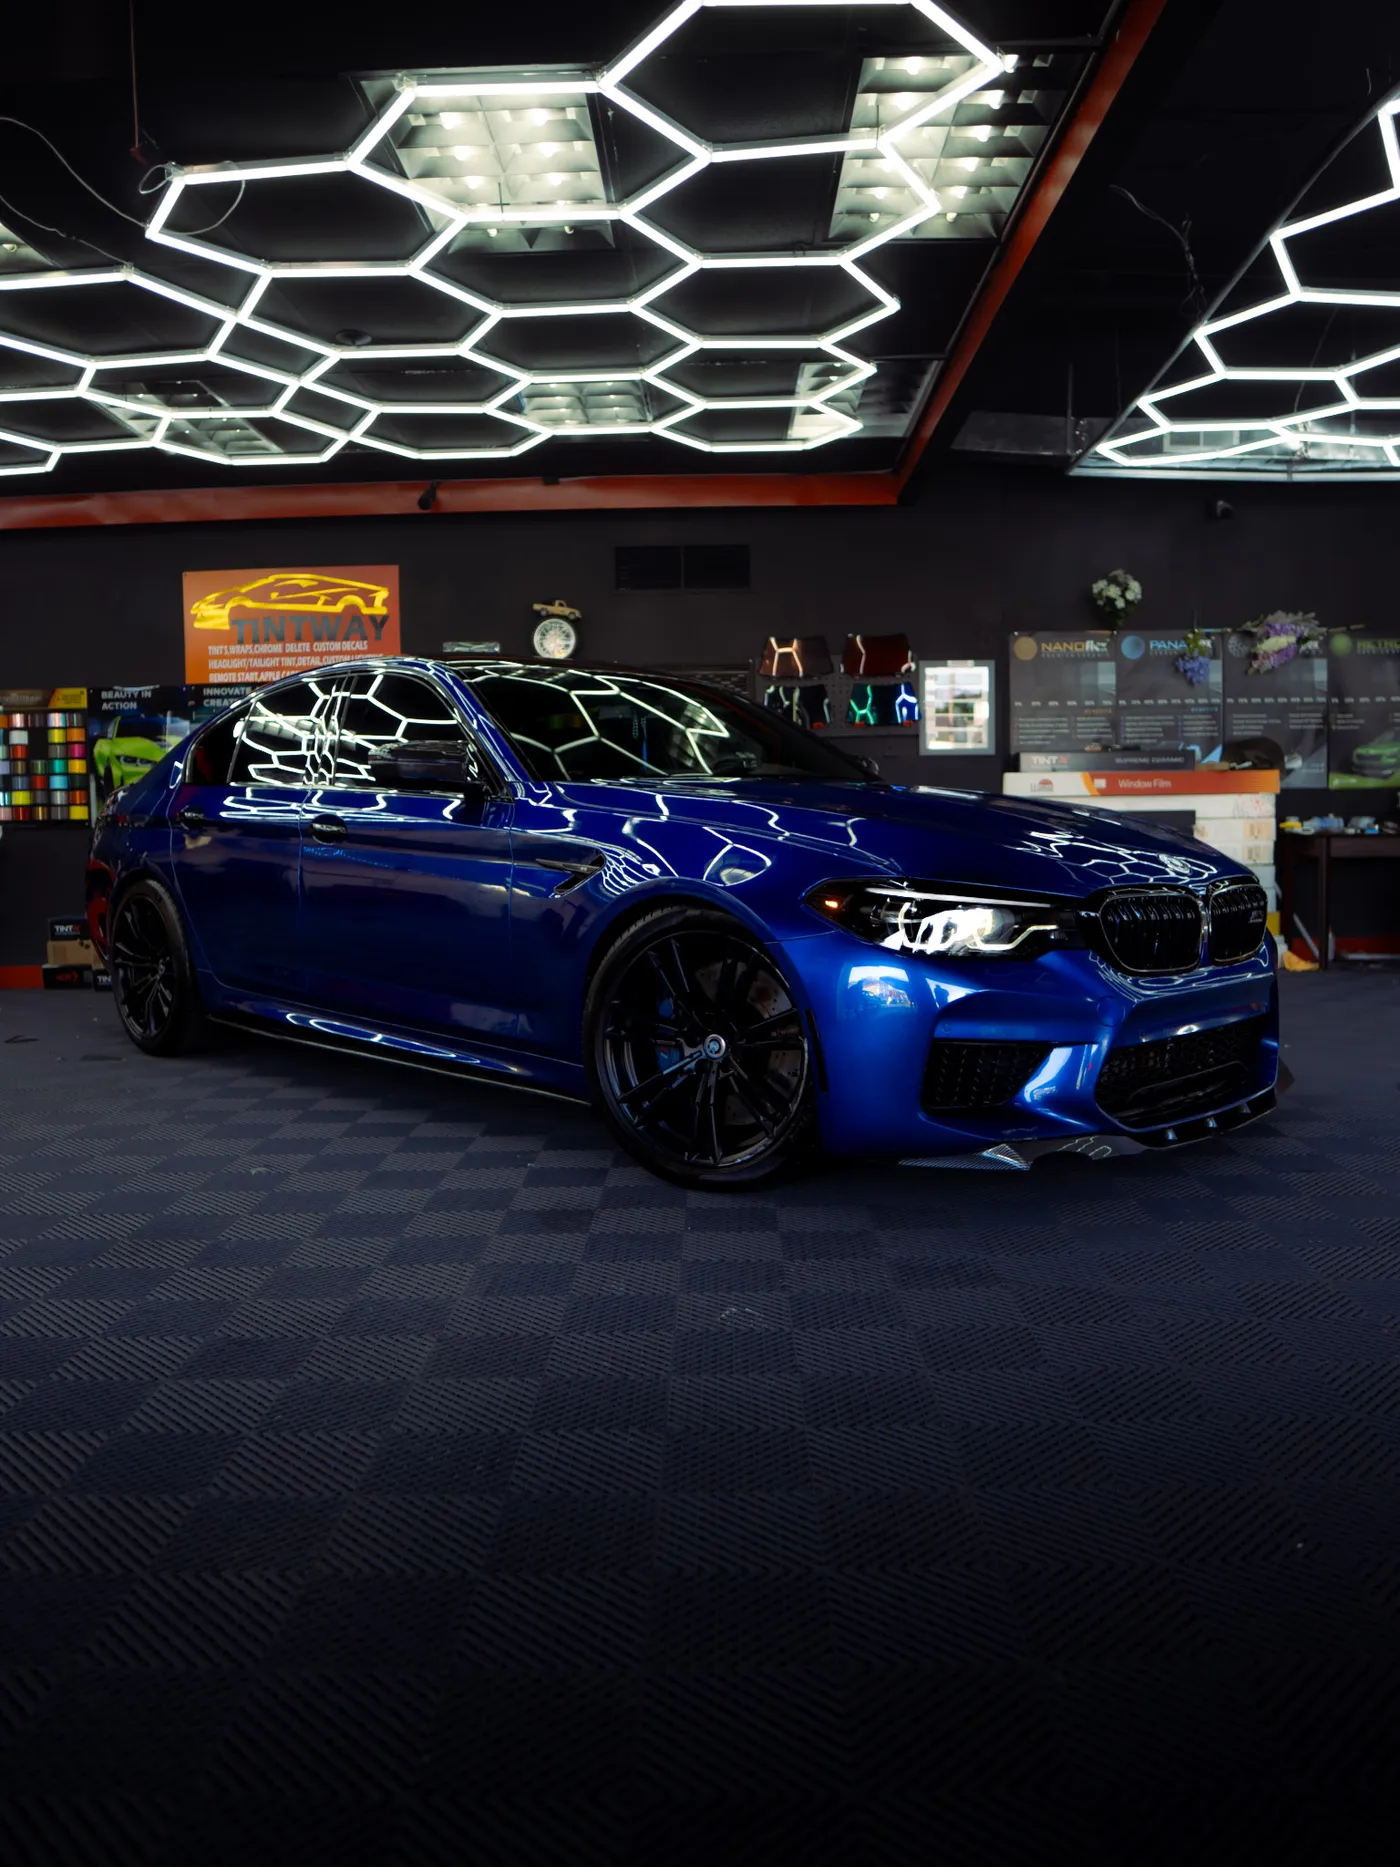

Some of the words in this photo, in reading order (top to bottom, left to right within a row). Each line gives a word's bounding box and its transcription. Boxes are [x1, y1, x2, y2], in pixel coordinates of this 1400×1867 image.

[231, 615, 389, 644] TINTWAY
[285, 642, 310, 652] DELETE
[313, 641, 340, 651] CUSTOM
[342, 639, 368, 651] DECALS
[208, 672, 236, 683] REMOTE
[101, 691, 138, 700] BEAUTY
[141, 690, 151, 698] IN
[101, 702, 137, 711] ACTION
[1118, 779, 1152, 788] Window
[1153, 778, 1172, 788] Film
[97, 975, 112, 983] TIN
